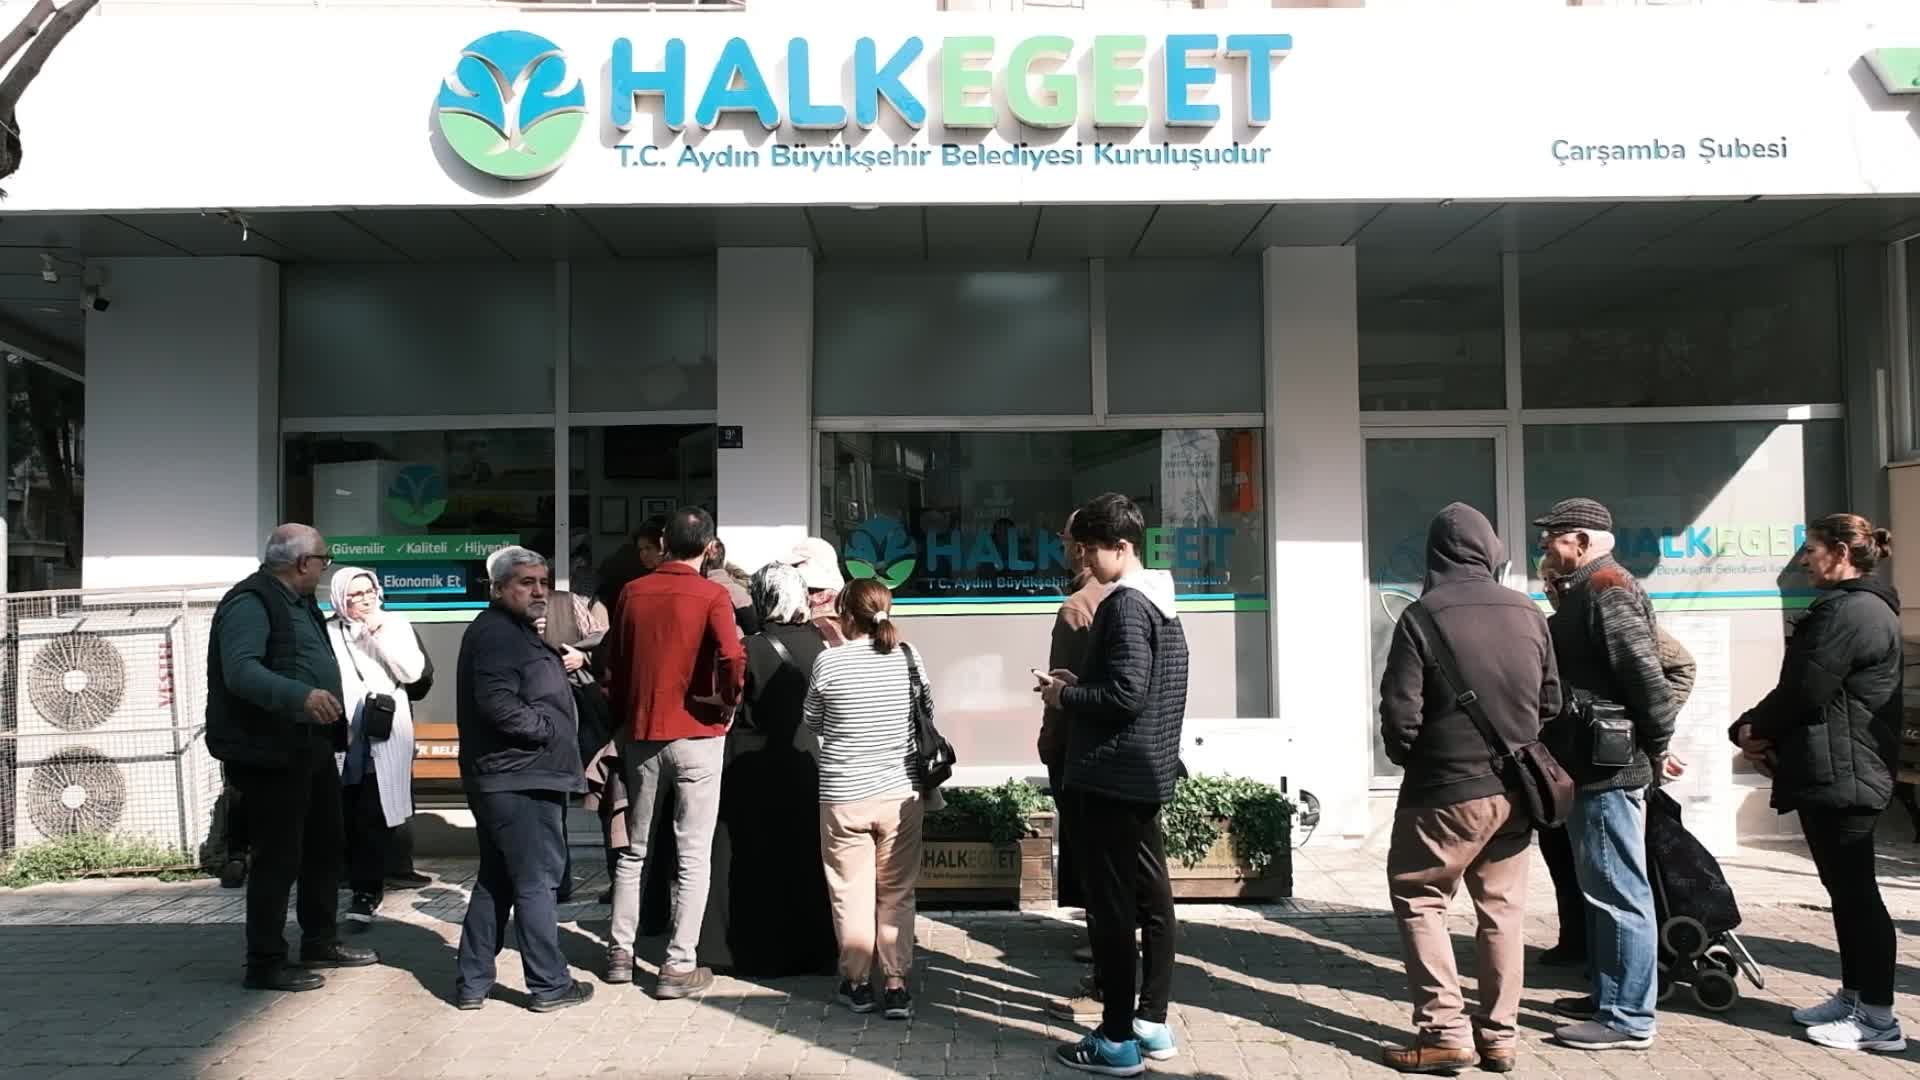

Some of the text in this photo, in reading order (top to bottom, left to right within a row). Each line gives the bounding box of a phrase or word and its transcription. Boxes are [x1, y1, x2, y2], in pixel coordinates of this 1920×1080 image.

[614, 141, 1271, 173] T.C. Aydın Büyükşehir Belediyesi Kuruluşudur
[1551, 136, 1788, 167] Çarşamba Şubesi
[331, 543, 385, 555] Güvenilir
[406, 541, 447, 554] Kaliteli
[384, 574, 461, 588] Ekonomik Et
[158, 641, 175, 707] VESTEL
